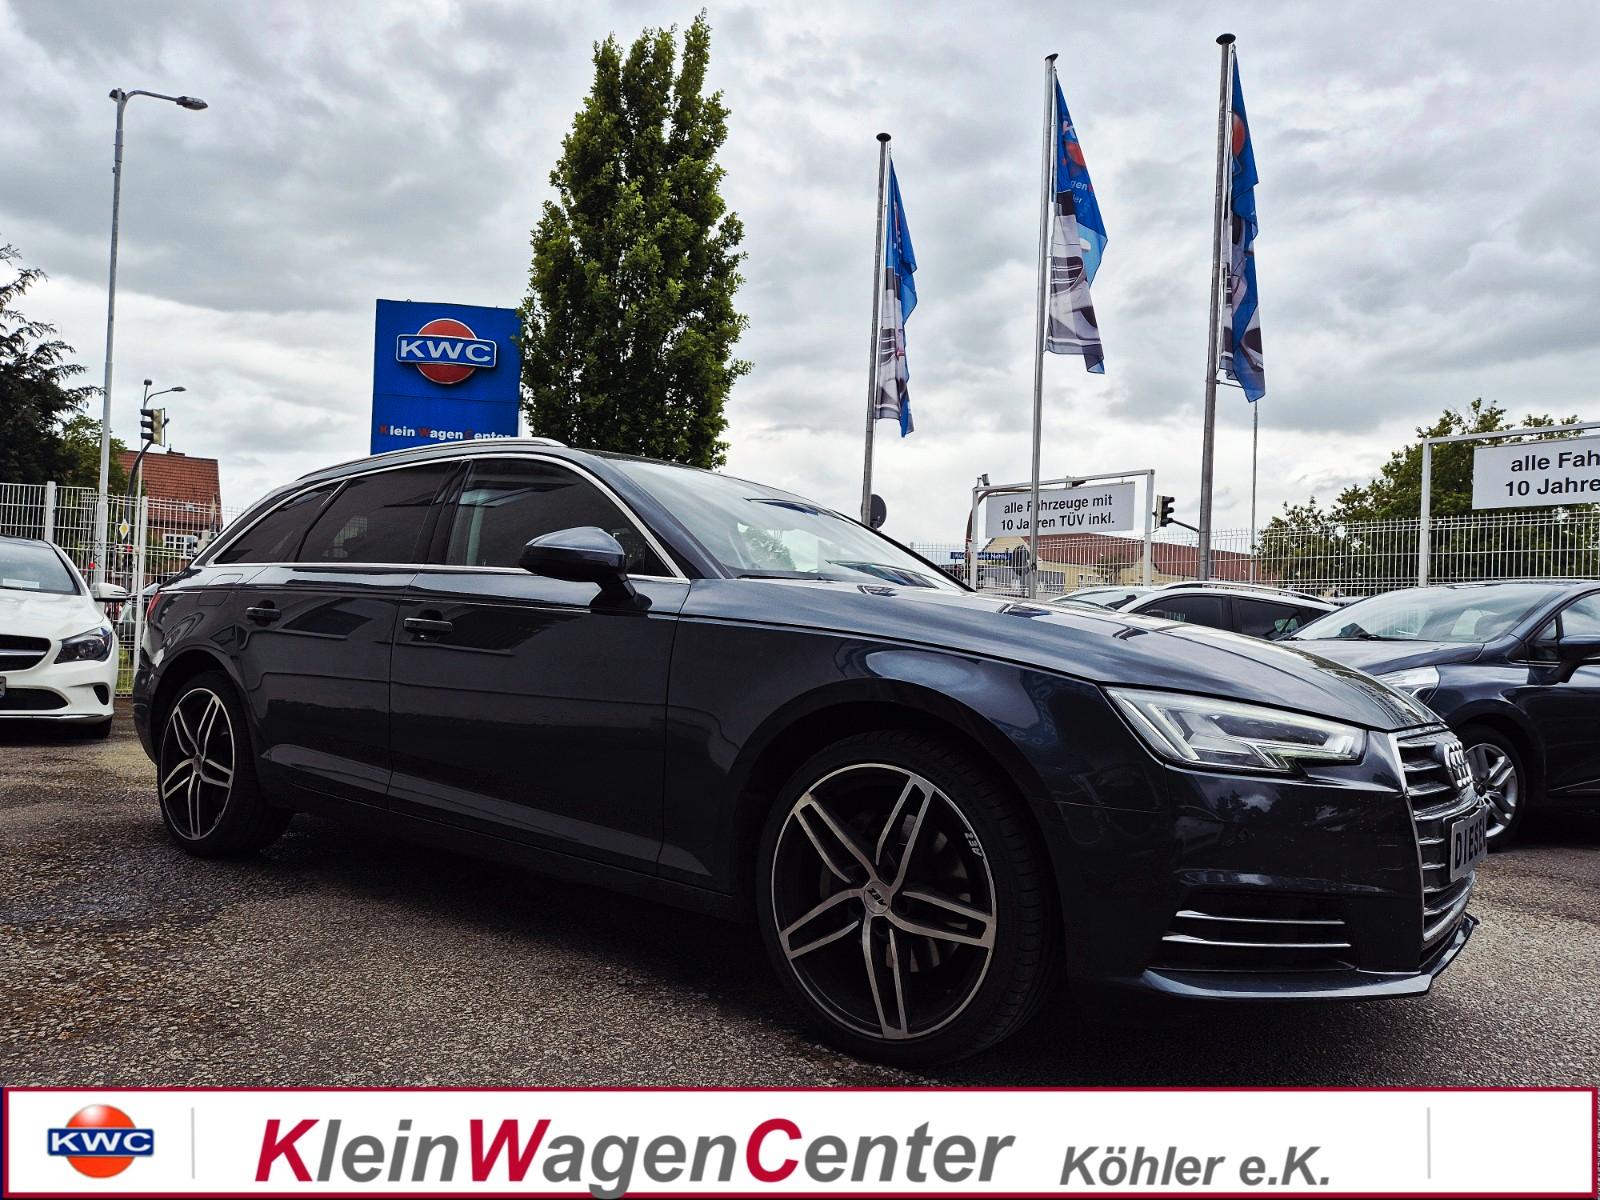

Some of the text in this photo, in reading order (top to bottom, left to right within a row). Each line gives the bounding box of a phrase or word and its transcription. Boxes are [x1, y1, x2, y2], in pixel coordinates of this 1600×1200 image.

[400, 339, 491, 362] KWC
[379, 424, 415, 437] Klein
[418, 427, 463, 440] Wagen
[1511, 450, 1600, 472] alle Fah
[1505, 476, 1600, 498] 10 Jahre
[1004, 494, 1113, 514] alle Fhrzeuge mit
[1001, 510, 1115, 531] 10 Jaren TÜV inkl.
